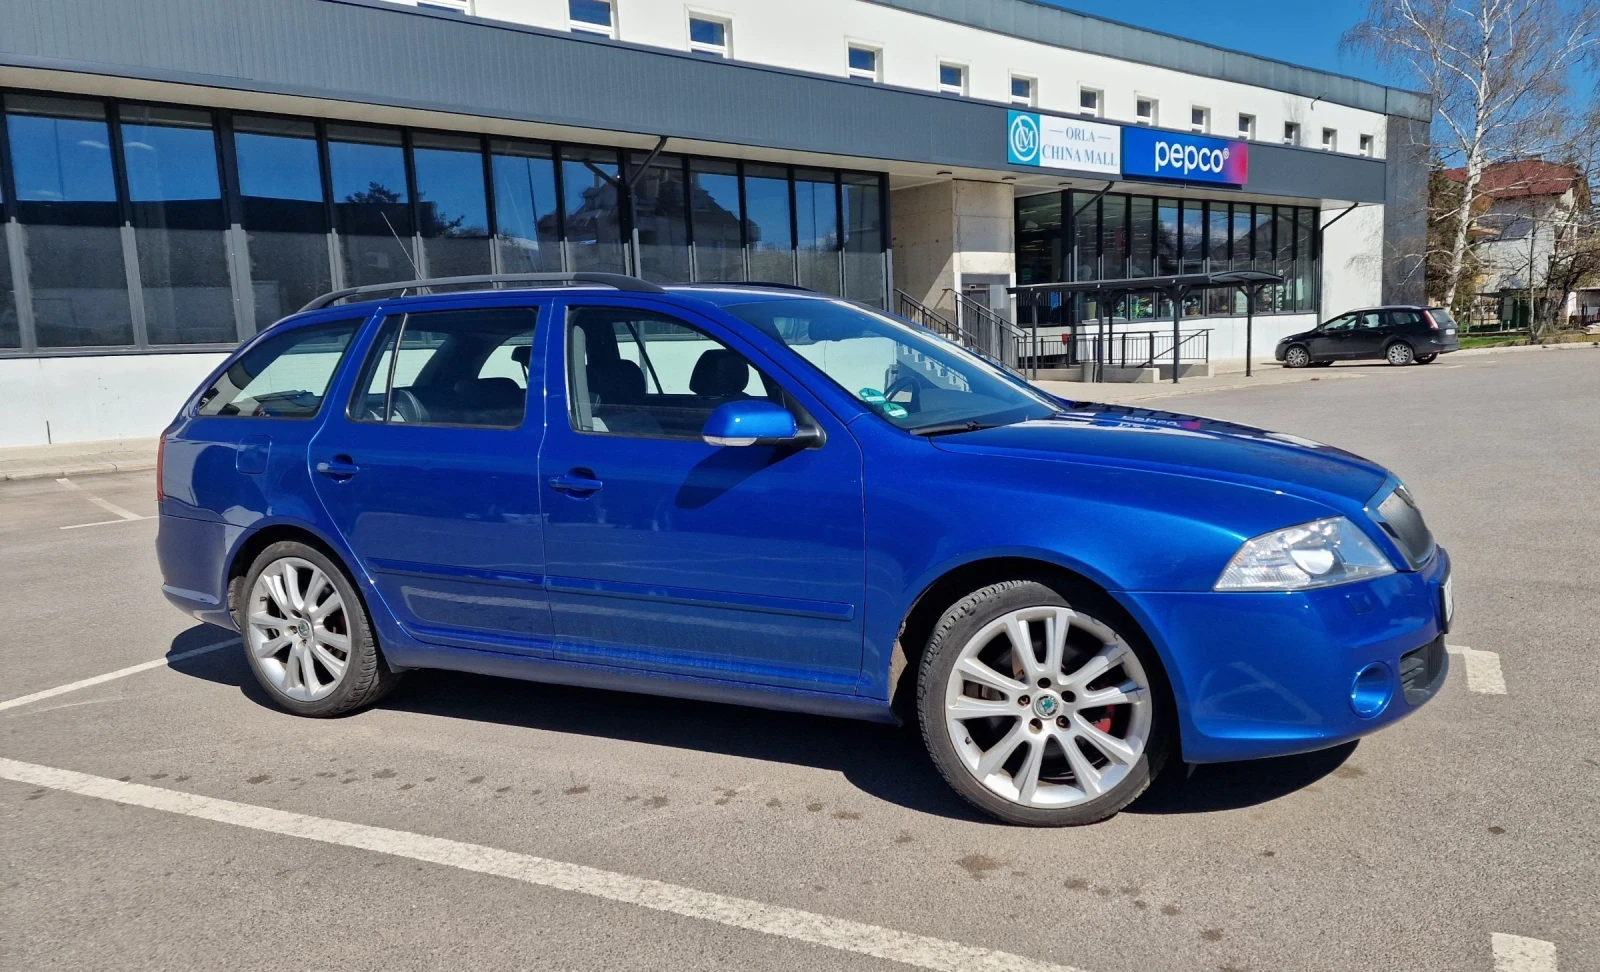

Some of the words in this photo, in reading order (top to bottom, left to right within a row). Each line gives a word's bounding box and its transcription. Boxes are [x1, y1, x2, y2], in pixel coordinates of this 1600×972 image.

[1065, 126, 1095, 143] ORLA
[1042, 144, 1081, 163] CHINA
[1084, 149, 1117, 166] MALL
